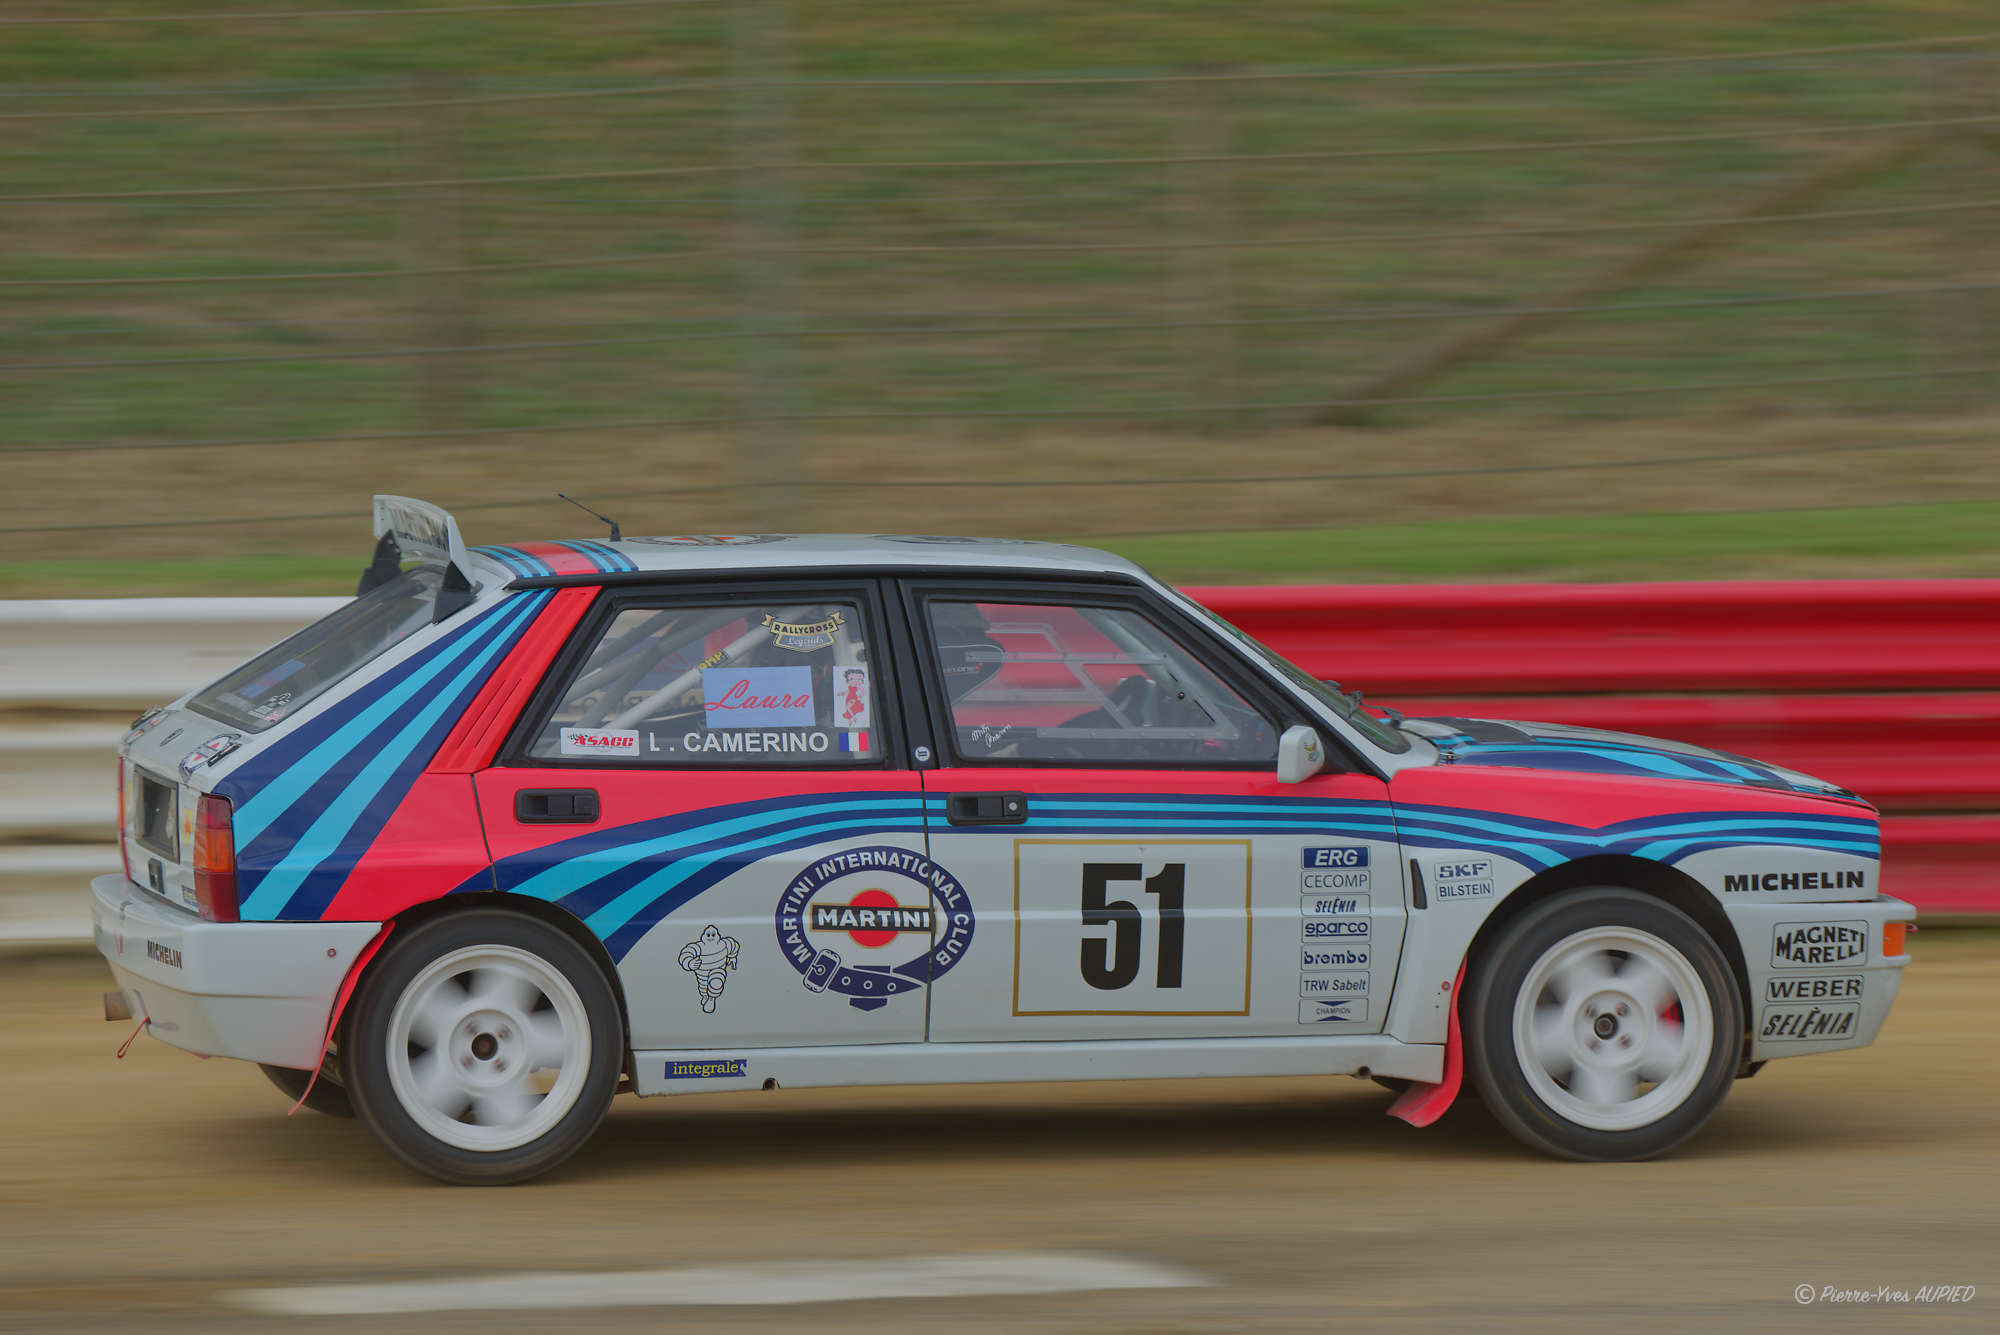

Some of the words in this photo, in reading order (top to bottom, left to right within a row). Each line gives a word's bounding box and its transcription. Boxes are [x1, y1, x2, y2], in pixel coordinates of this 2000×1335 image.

[774, 622, 834, 634] RALLYCROSS
[703, 679, 811, 711] Laura
[683, 733, 829, 752] CAMERINO
[1315, 850, 1358, 866] ERG
[1439, 863, 1487, 878] SKF
[1304, 875, 1367, 888] CECOMP
[1724, 871, 1864, 892] MICHELIN
[1439, 884, 1491, 897] BILSTEIN
[783, 876, 814, 964] MARTINI
[815, 851, 963, 908] INTERNATIONAL
[936, 913, 970, 967] CLUB
[817, 908, 931, 928] MARTINI
[1080, 863, 1185, 990] 51
[1304, 921, 1368, 937] sparco
[1776, 926, 1865, 956] MAGNETI
[1776, 936, 1865, 963] MARELLI
[147, 940, 182, 968] MICHELIN
[1304, 951, 1367, 964] brembo
[1304, 980, 1329, 991] TRW
[1332, 980, 1366, 991] Sabelt
[1769, 979, 1861, 998] WEBER
[1315, 1007, 1351, 1015] CHAMPION
[673, 1061, 738, 1077] integrale
